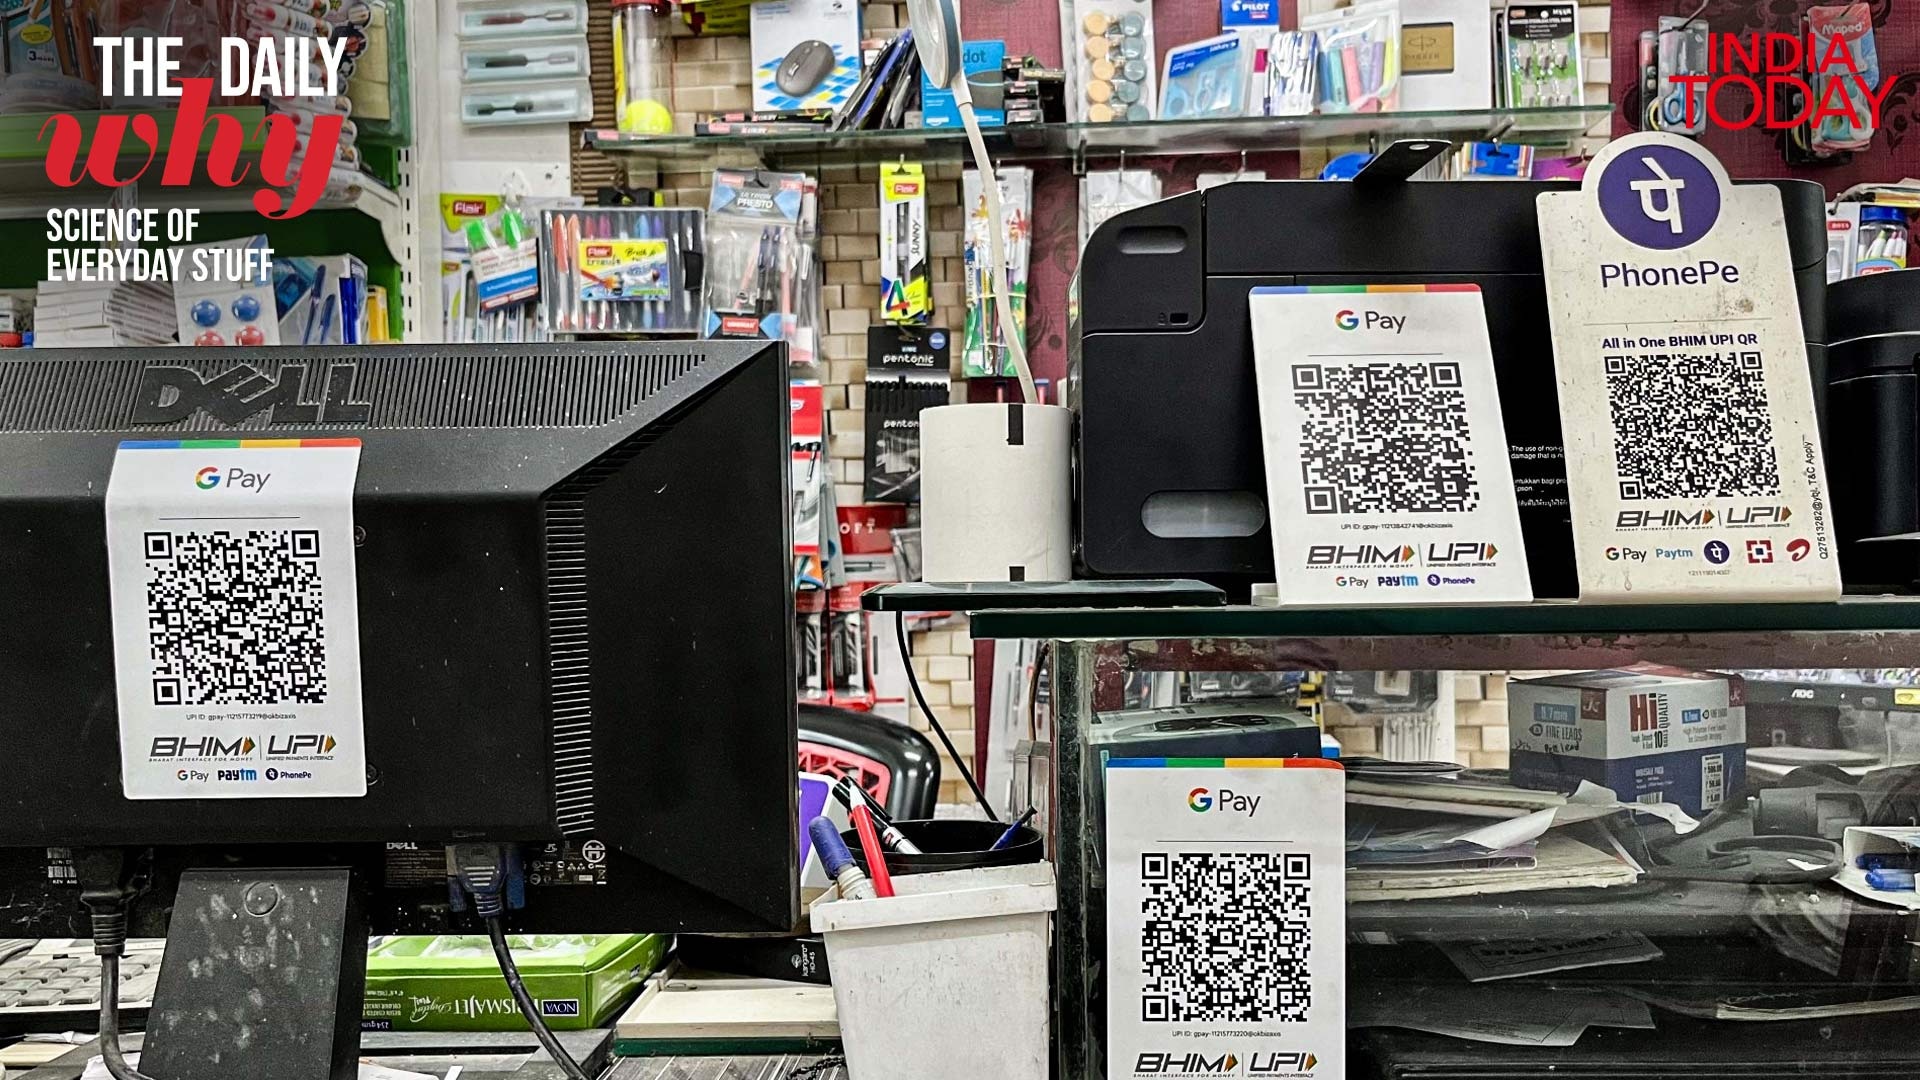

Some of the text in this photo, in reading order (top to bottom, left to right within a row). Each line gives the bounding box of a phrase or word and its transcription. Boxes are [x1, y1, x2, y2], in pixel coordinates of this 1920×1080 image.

[1242, 3, 1270, 11] PILOT
[1822, 22, 1863, 36] Maped
[1629, 157, 1685, 233] पे
[454, 202, 484, 214] Flair
[911, 219, 922, 256] SUNNY
[1600, 261, 1739, 288] PhonePe
[1365, 311, 1406, 334] Pay
[1602, 333, 1758, 349] All in One BHIM UPI QR
[883, 354, 934, 366] pentonic
[131, 362, 372, 426] DELL
[1803, 441, 1815, 465] Apply
[226, 467, 271, 494] Pay
[1617, 506, 1780, 526] BHIM UPI
[1307, 543, 1486, 564] BHIM UPI
[1622, 547, 1647, 563] Pay
[1655, 548, 1693, 560] Paytm
[1349, 576, 1369, 588] Pay
[1443, 577, 1475, 585] PhonePe
[1791, 689, 1814, 699] AOC
[1629, 693, 1658, 732] Hi
[1658, 693, 1669, 729] QUALITY
[1545, 725, 1582, 743] FINE LEADS
[1654, 731, 1663, 748] 10
[150, 735, 325, 757] BHIM UPI
[190, 770, 209, 782] Pay
[280, 771, 312, 779] PhonePe
[1219, 789, 1261, 817] Pay
[387, 842, 418, 850] DELL
[545, 1002, 576, 1014] NOVA
[1134, 1052, 1308, 1073] BHIM UPI
